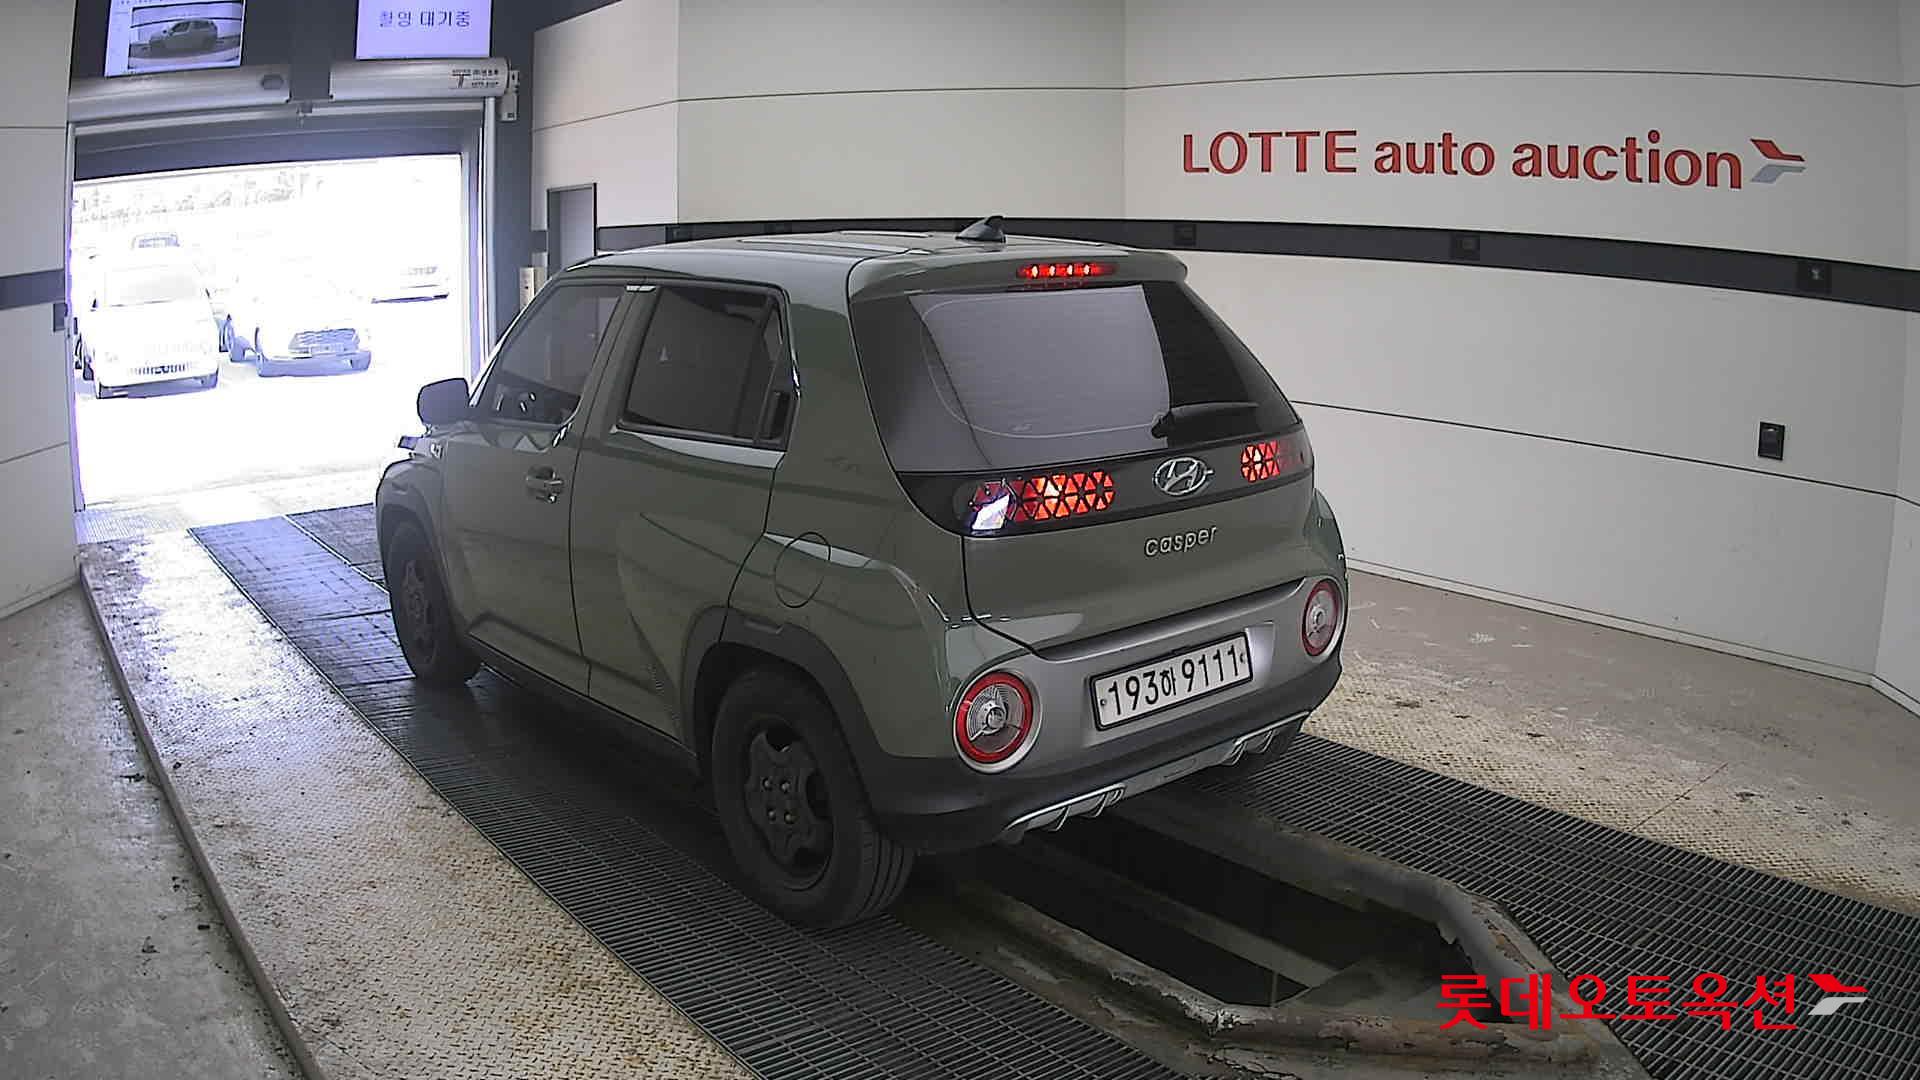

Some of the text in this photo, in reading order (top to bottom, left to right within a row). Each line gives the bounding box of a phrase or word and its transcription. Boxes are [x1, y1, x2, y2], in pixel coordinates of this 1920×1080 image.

[420, 10, 471, 28] 대기중
[1183, 129, 1742, 189] LOTTE auto auction
[1145, 526, 1217, 556] casper
